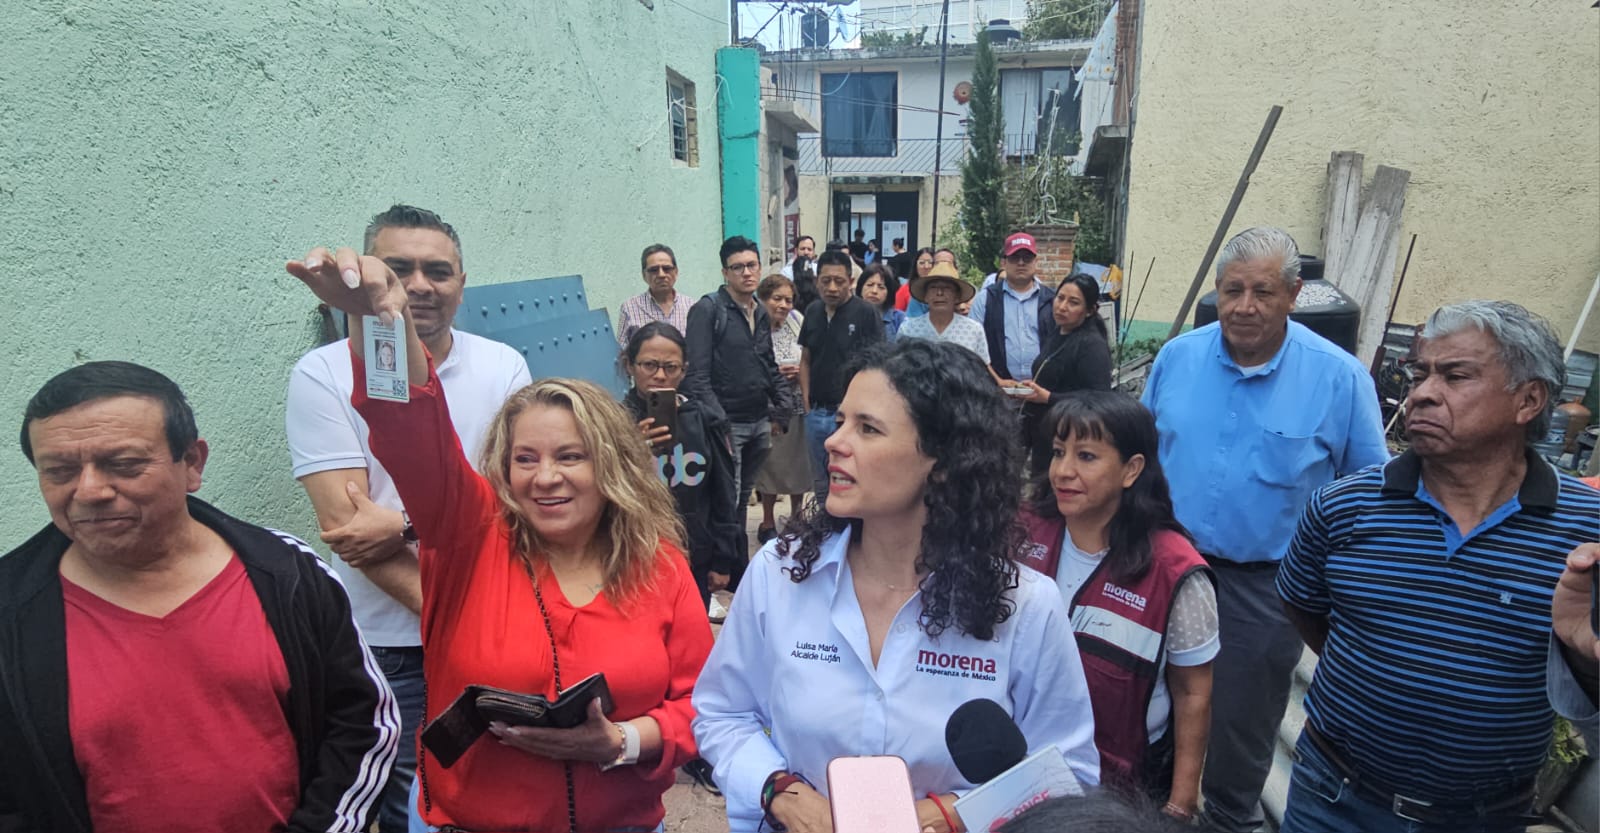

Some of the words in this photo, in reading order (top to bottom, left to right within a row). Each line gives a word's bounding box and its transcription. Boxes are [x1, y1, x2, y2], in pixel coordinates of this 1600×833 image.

[1103, 582, 1147, 608] morena
[796, 641, 817, 650] Luisa
[818, 643, 838, 653] María
[791, 650, 819, 660] Alcalde
[820, 653, 841, 663] Luján
[918, 649, 996, 674] morena
[916, 664, 924, 672] La
[926, 668, 960, 677] esperanza
[961, 670, 970, 678] de
[972, 672, 996, 681] México
